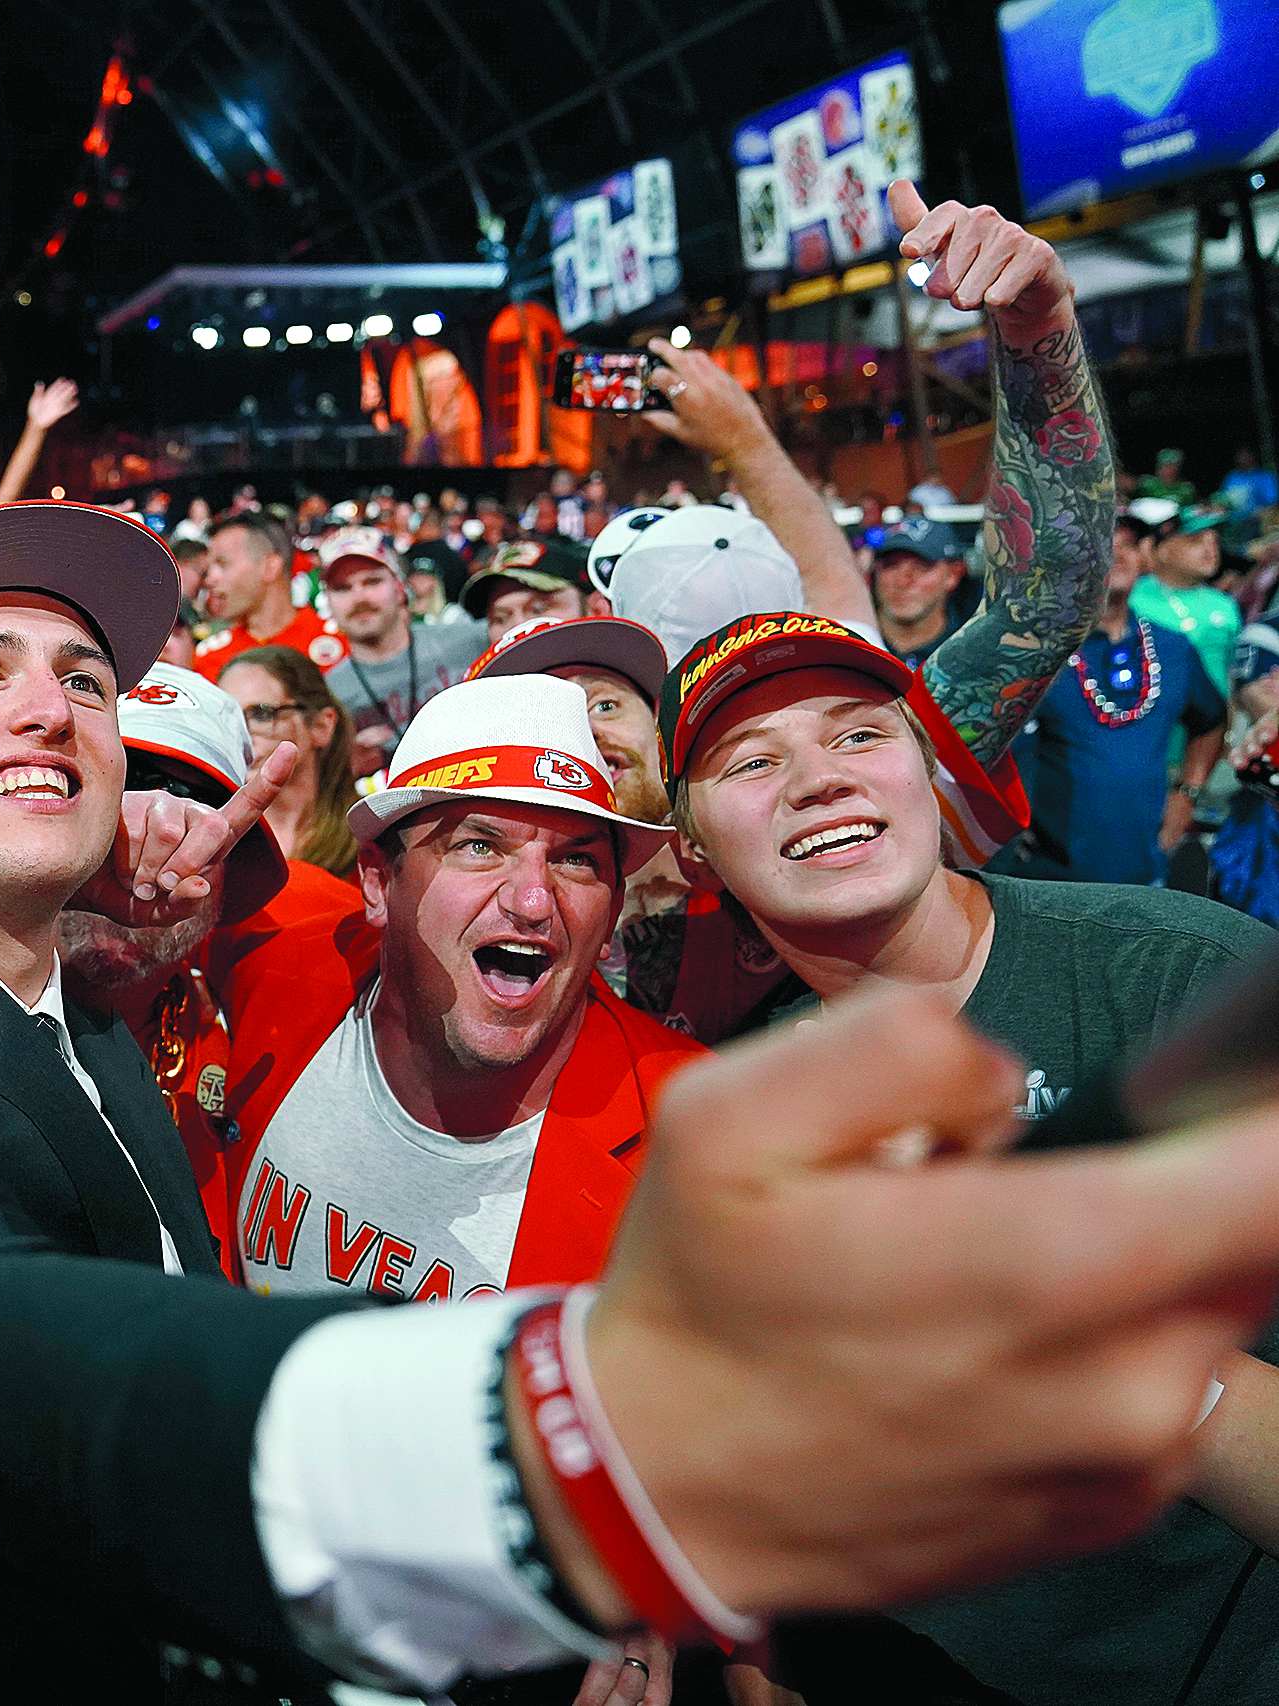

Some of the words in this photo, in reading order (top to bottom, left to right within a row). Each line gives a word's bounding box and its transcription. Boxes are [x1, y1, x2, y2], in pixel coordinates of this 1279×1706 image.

[551, 759, 583, 785] KC
[242, 1157, 311, 1271] IN
[325, 1202, 506, 1303] VEA
